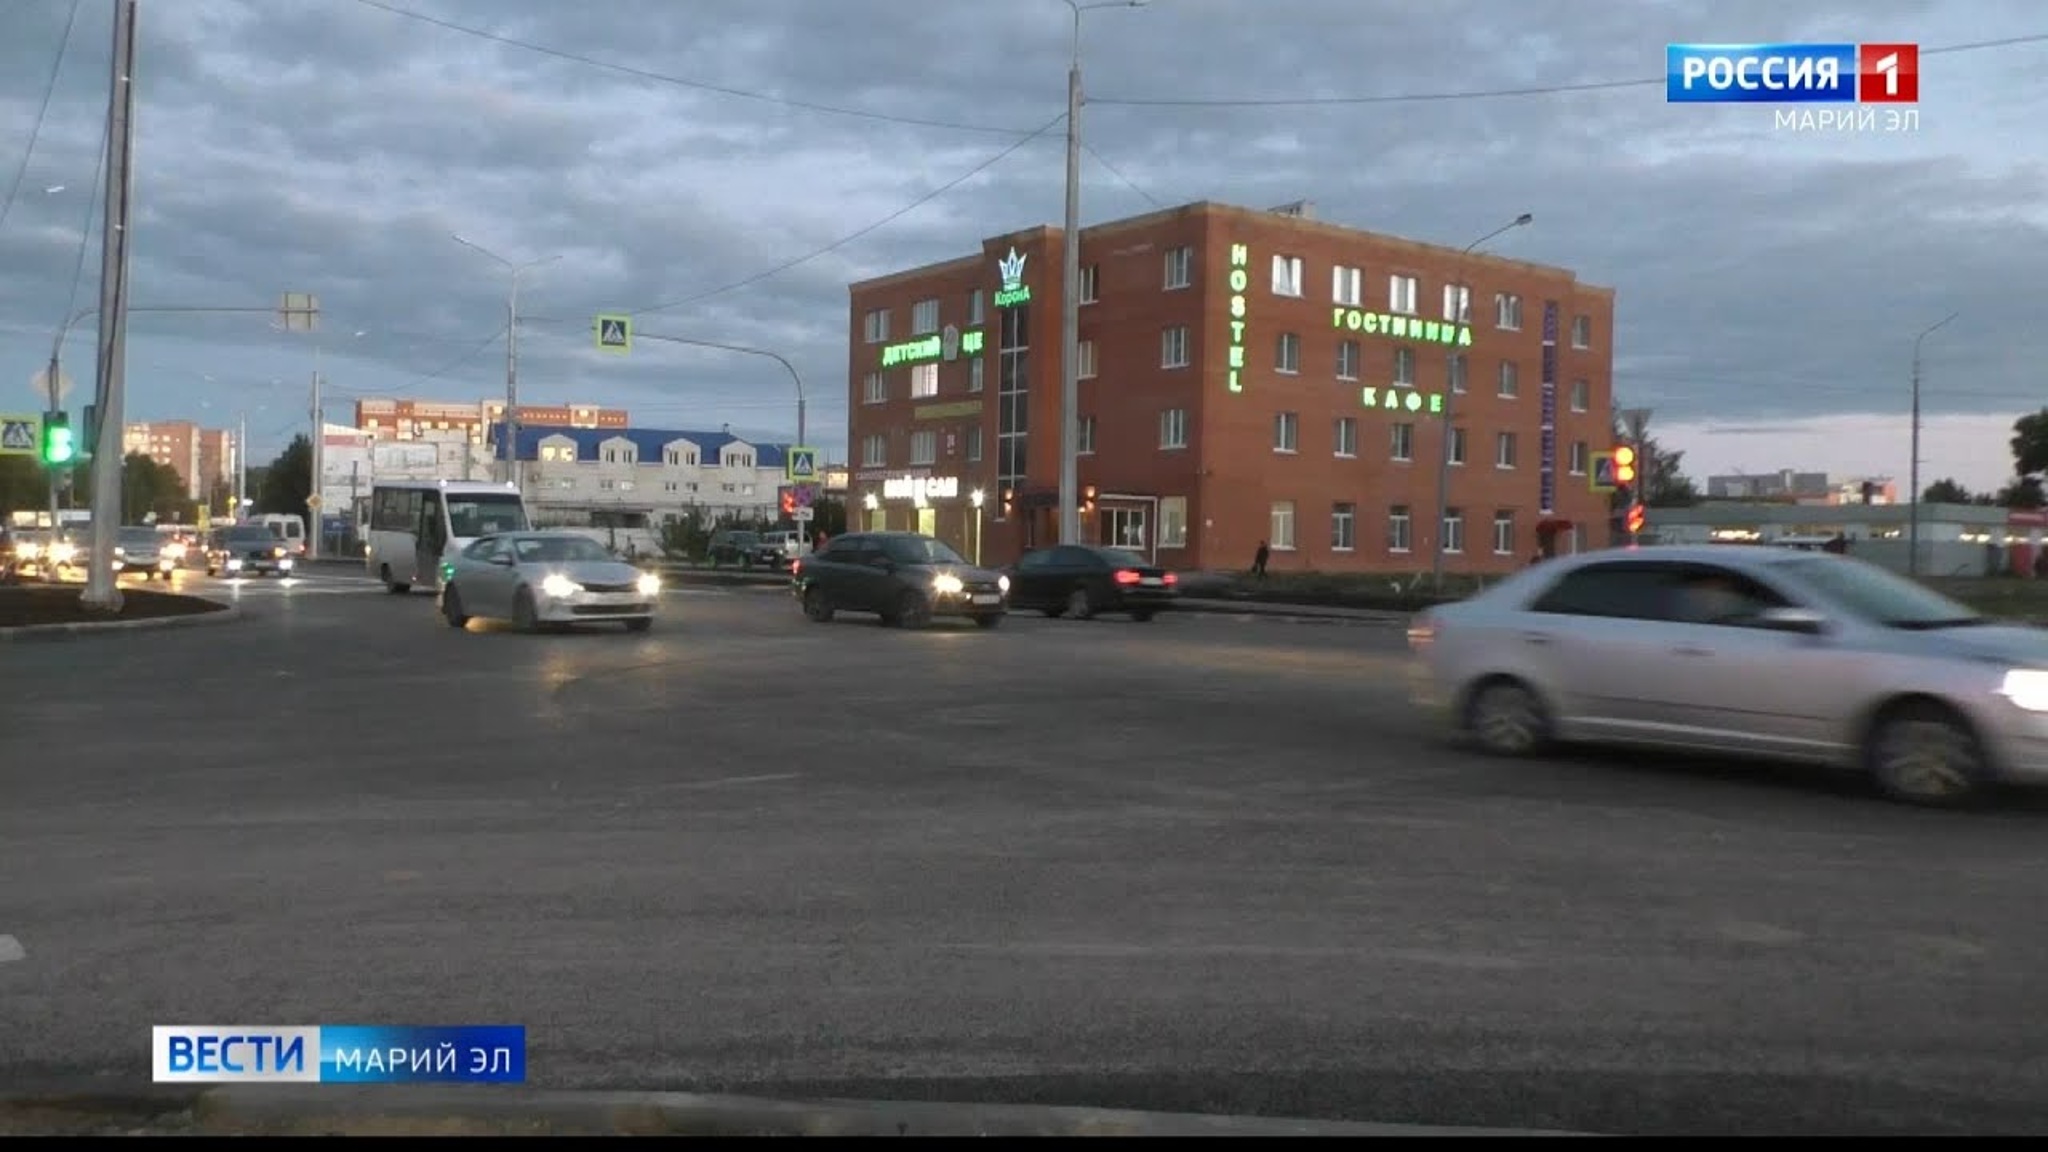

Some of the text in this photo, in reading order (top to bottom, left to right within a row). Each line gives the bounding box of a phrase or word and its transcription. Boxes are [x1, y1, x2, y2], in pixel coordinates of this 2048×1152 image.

[1228, 243, 1248, 394] HOSTEL
[1333, 308, 1472, 346] ГОСТИНИЦА
[882, 335, 941, 366] ДЕТСКИЙ
[1363, 387, 1443, 413] КАФЕ
